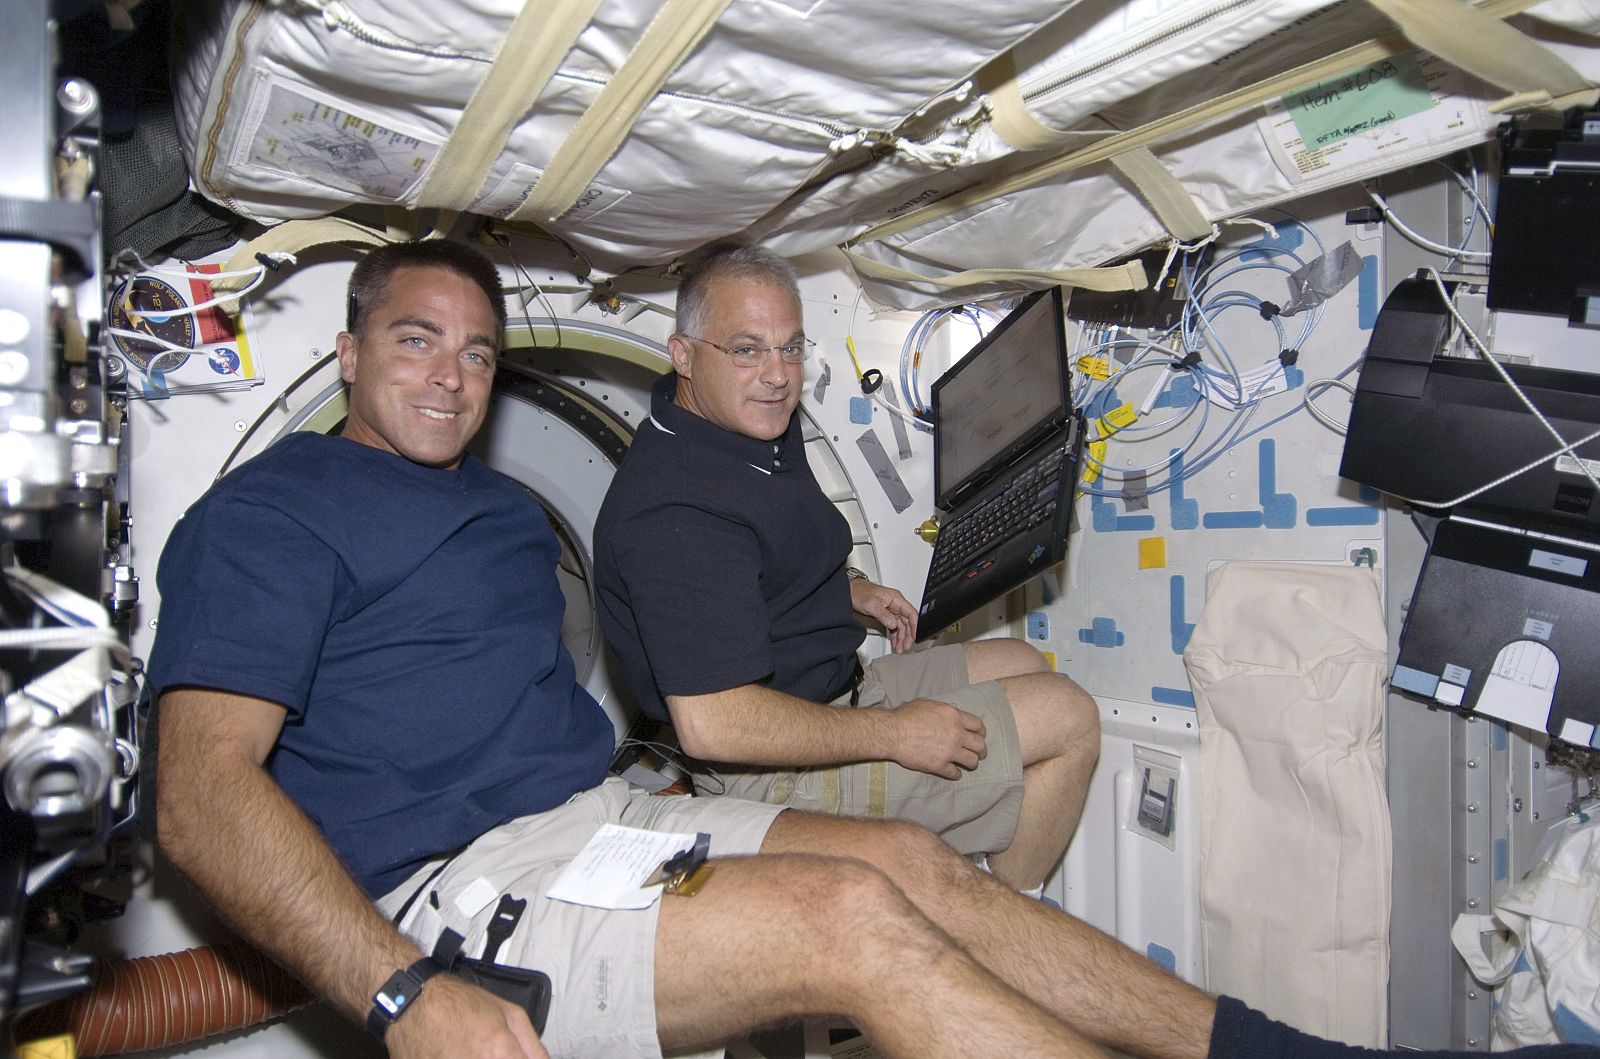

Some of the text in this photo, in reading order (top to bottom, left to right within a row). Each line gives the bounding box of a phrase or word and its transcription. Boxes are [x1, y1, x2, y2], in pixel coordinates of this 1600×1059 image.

[1301, 87, 1341, 111] Item
[149, 281, 164, 290] WOLF
[130, 351, 147, 367] KOPRA
